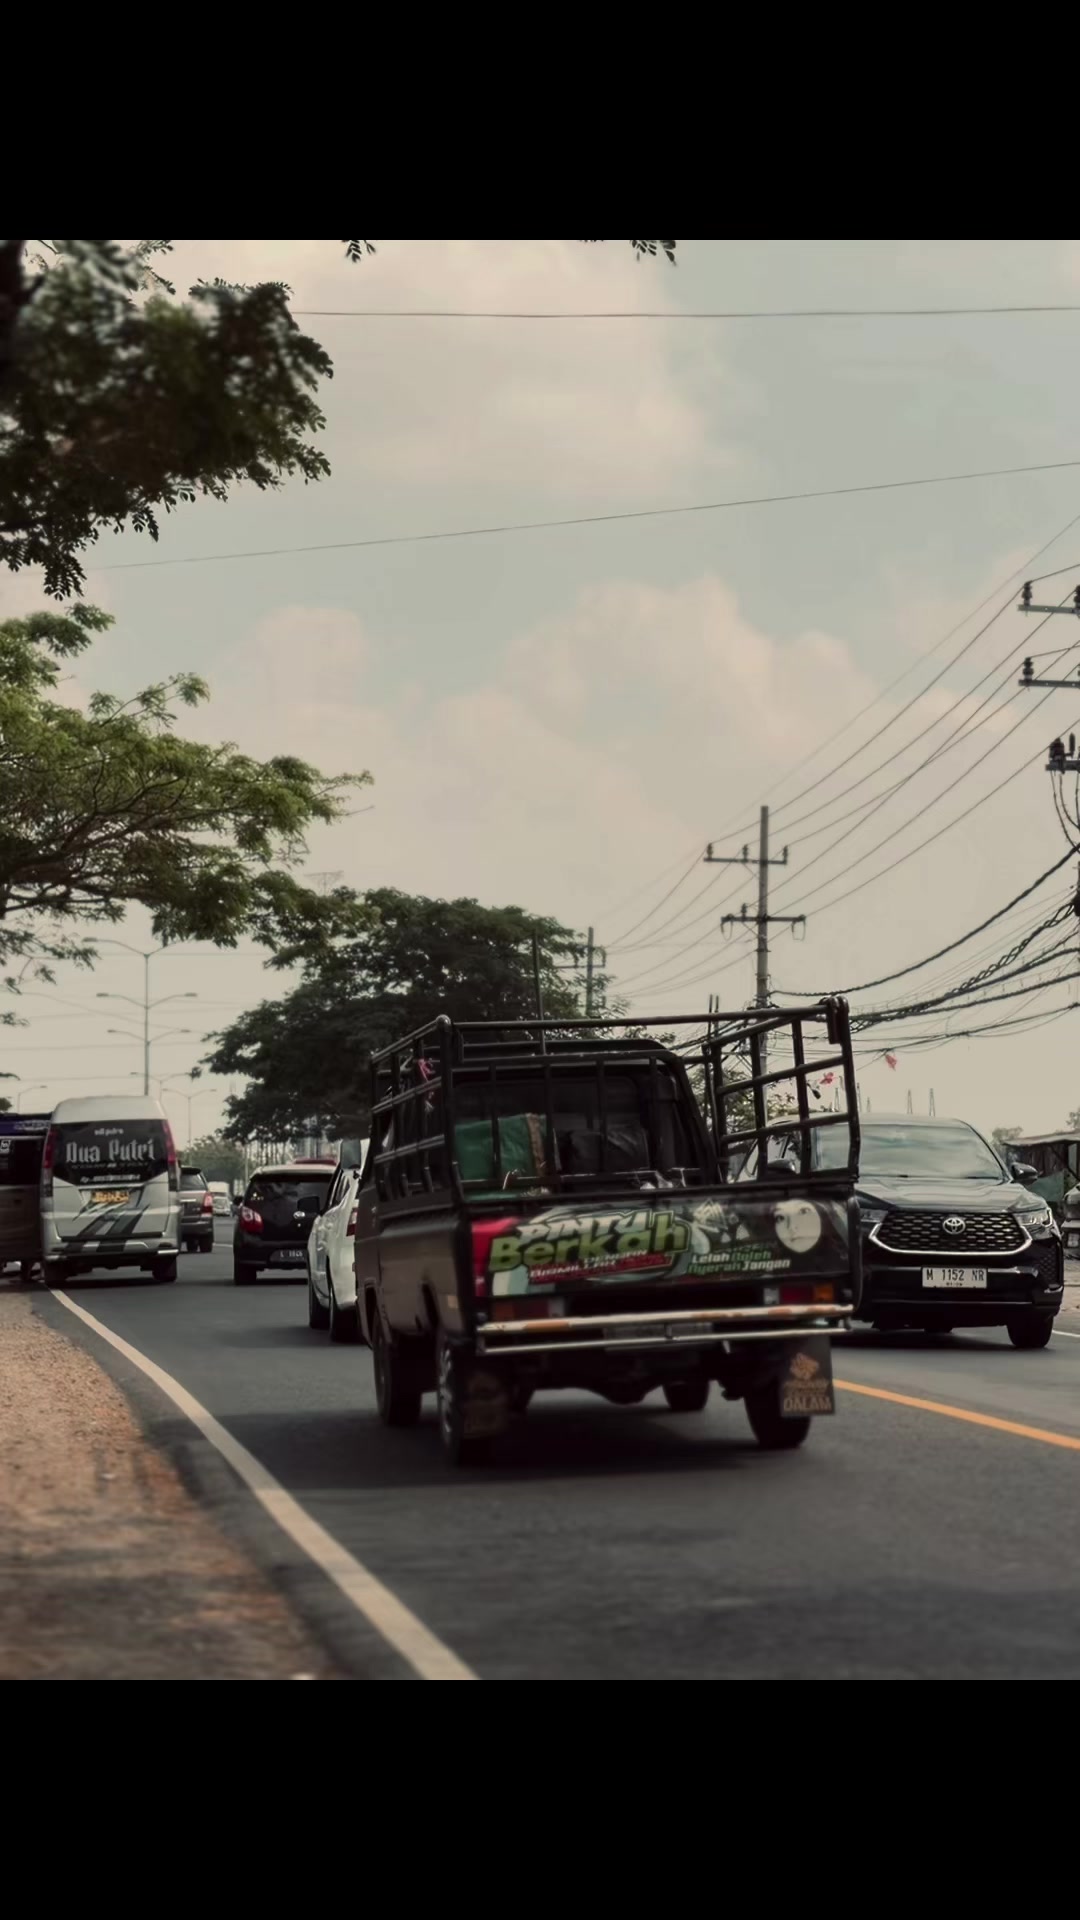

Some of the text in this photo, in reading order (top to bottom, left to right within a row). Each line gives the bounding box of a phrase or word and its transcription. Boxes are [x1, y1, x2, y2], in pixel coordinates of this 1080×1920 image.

[66, 1138, 155, 1162] Dua Putri
[489, 1210, 690, 1272] Berkah
[692, 1252, 730, 1264] Lelah
[742, 1259, 791, 1272] Jangan
[926, 1268, 985, 1281] M 1152 NR
